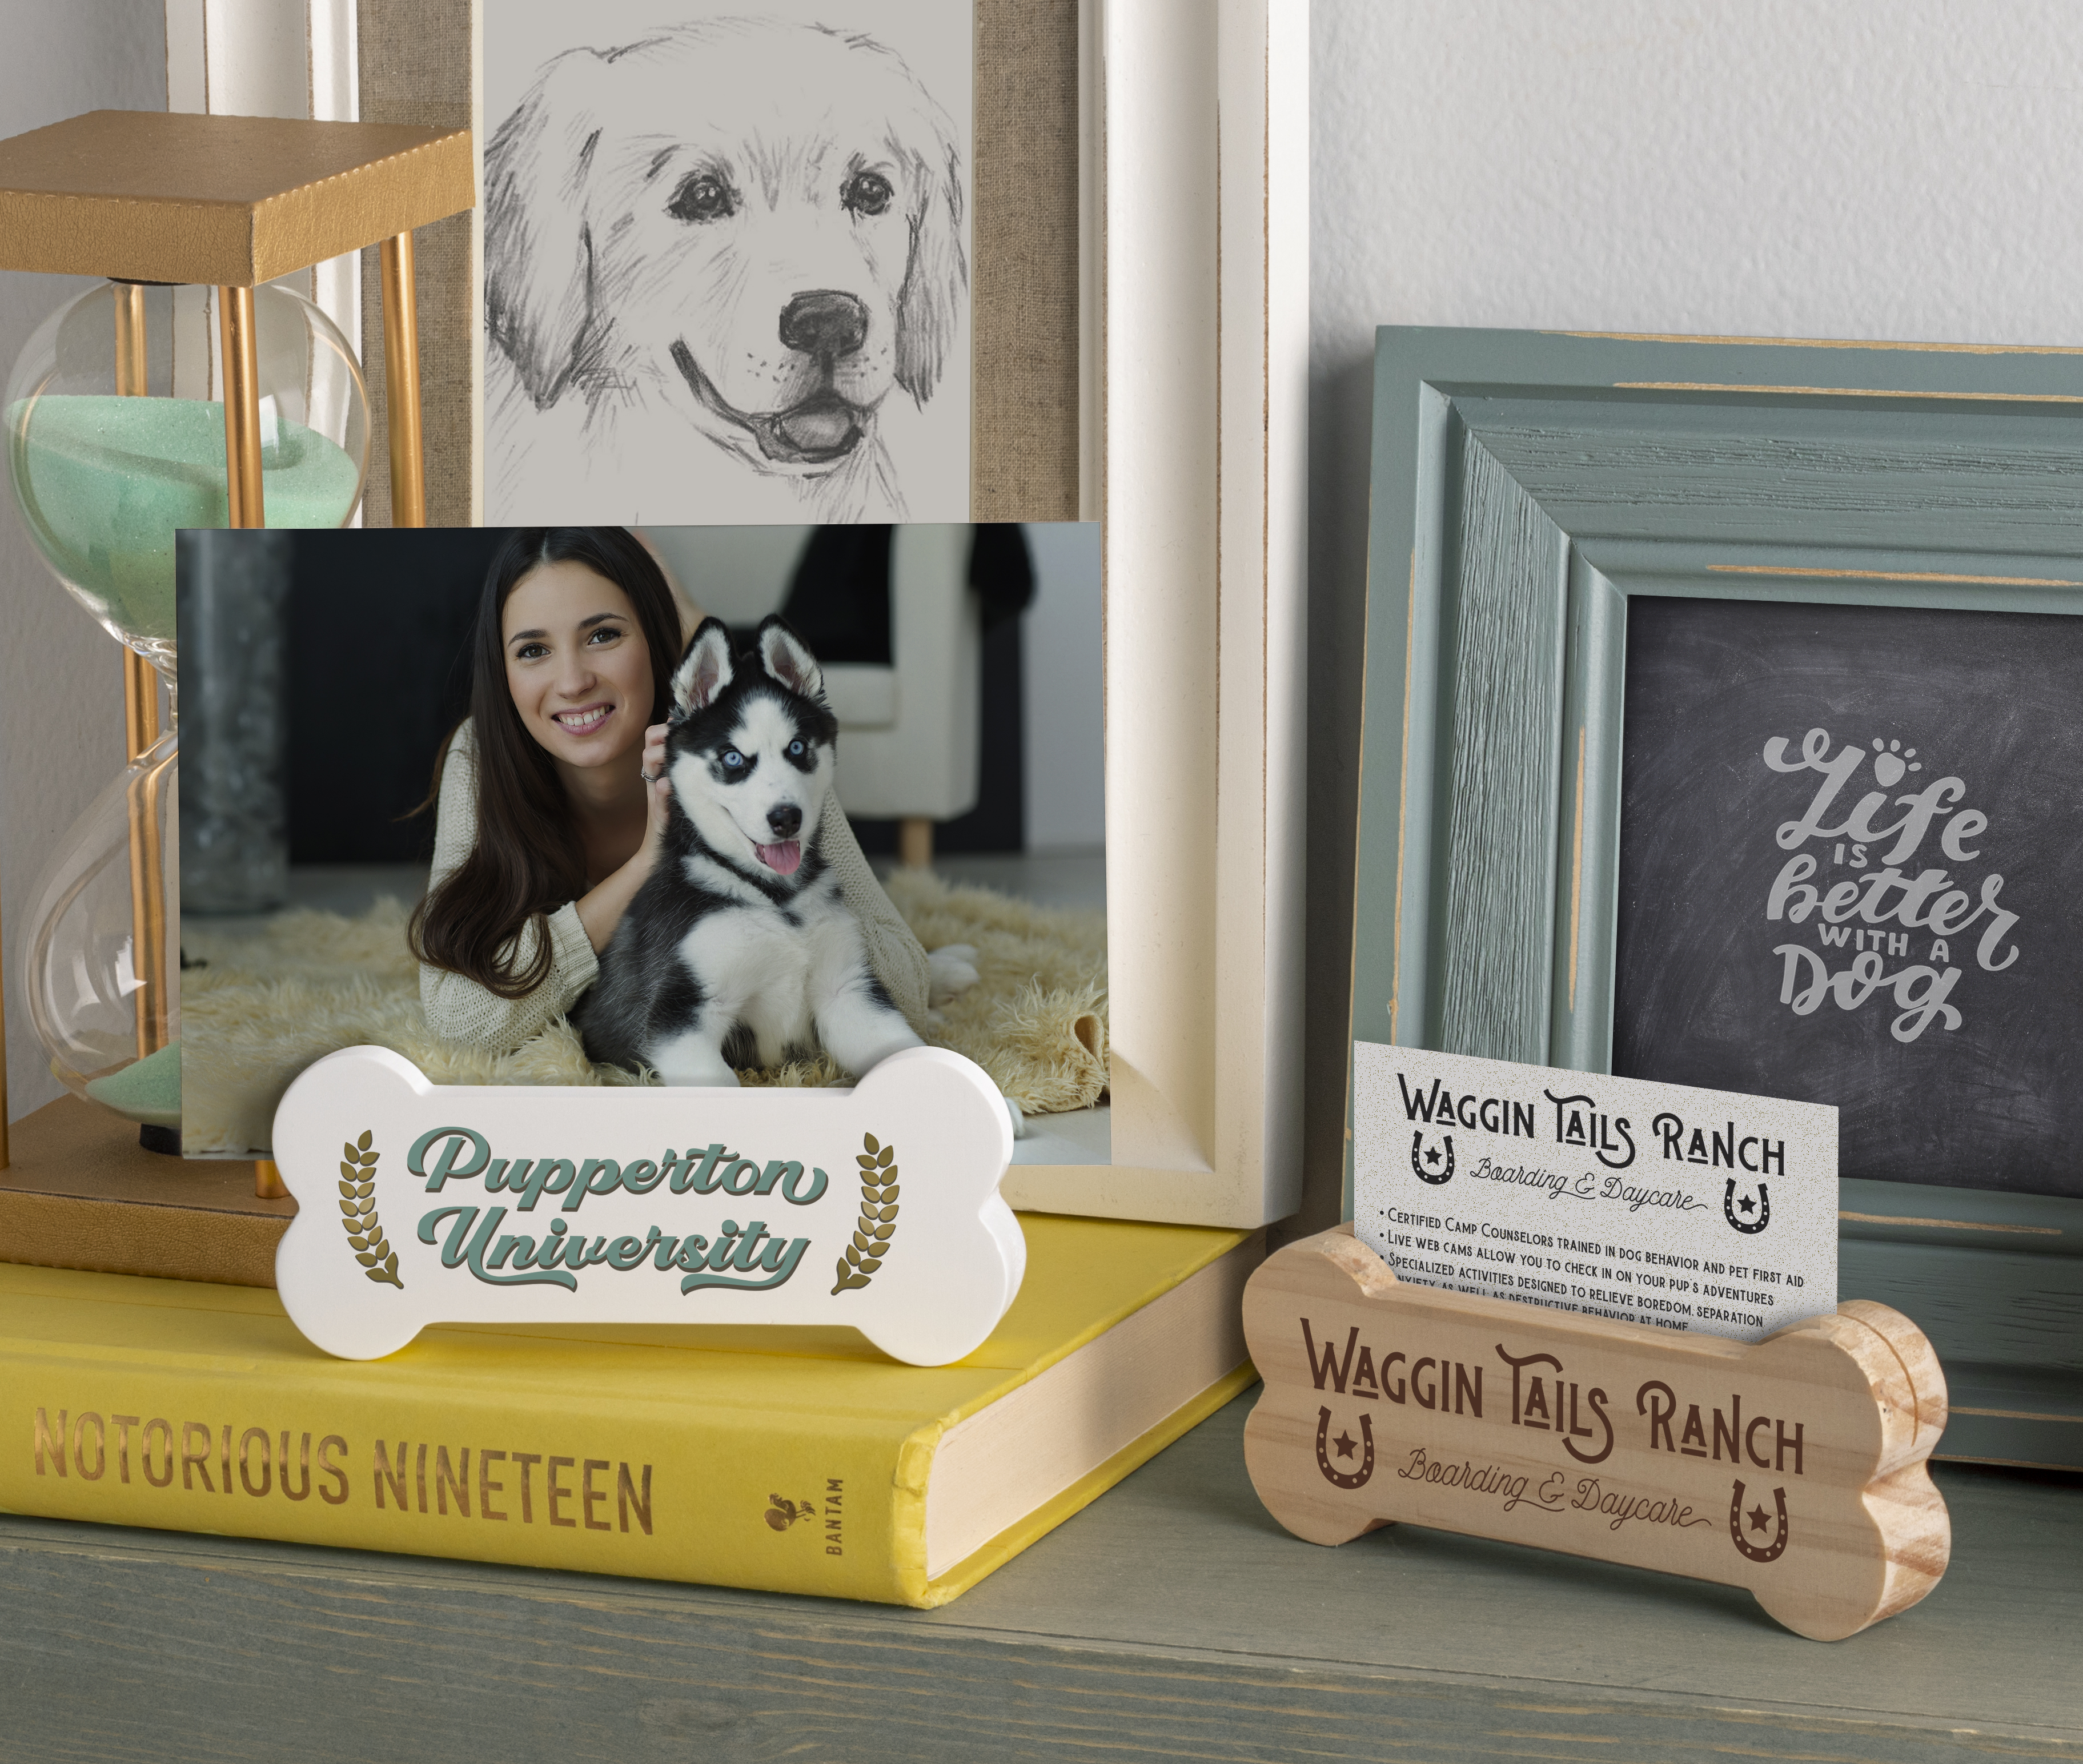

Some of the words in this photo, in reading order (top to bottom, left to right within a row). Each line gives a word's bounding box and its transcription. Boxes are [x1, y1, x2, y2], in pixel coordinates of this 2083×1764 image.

[1763, 728, 1988, 866] Life
[1833, 843, 1868, 868] IS
[1767, 854, 2020, 971] better
[1817, 923, 1909, 957] WITH
[1929, 939, 1949, 963] A
[1772, 943, 1962, 1043] Dog
[407, 1126, 830, 1213] Pupperton
[1470, 1157, 1596, 1200] Boarding
[1575, 1172, 1595, 1195] &
[1600, 1176, 1709, 1213] Daycare
[416, 1206, 813, 1297] University
[1415, 1236, 1440, 1252] WEB
[1443, 1241, 1473, 1257] CAMS
[1476, 1247, 1516, 1264] ALLOW
[1520, 1254, 1543, 1268] YOU
[1546, 1258, 1562, 1272] TO
[1564, 1261, 1598, 1278] CHECK
[1602, 1267, 1612, 1280] IN
[1616, 1270, 1632, 1283] ON
[1636, 1273, 1666, 1289] YOUR
[1703, 1284, 1775, 1307] ADVENTURES
[1557, 1237, 1602, 1255] TRAINED
[1605, 1245, 1616, 1258] IN
[1619, 1247, 1642, 1262] DOG
[1645, 1251, 1699, 1271] BEHAVIOR
[1703, 1261, 1725, 1275] AND
[1729, 1265, 1749, 1279] PET
[1752, 1268, 1782, 1284] FIRST
[1785, 1274, 1804, 1288] AID
[1458, 1267, 1515, 1286] ACTIVITIES
[1518, 1276, 1568, 1295] DESIGNED
[1571, 1284, 1586, 1298] TO
[1589, 1288, 1634, 1307] RELIEVE
[1696, 1305, 1764, 1328] SEPARATION
[33, 1407, 350, 1506] NOTORIOUS
[372, 1438, 654, 1536] NINETEEN
[1397, 1447, 1566, 1512] Boarding
[1538, 1471, 1566, 1504] &
[1571, 1478, 1713, 1531] Daycare
[824, 1478, 844, 1557] BANTAM
